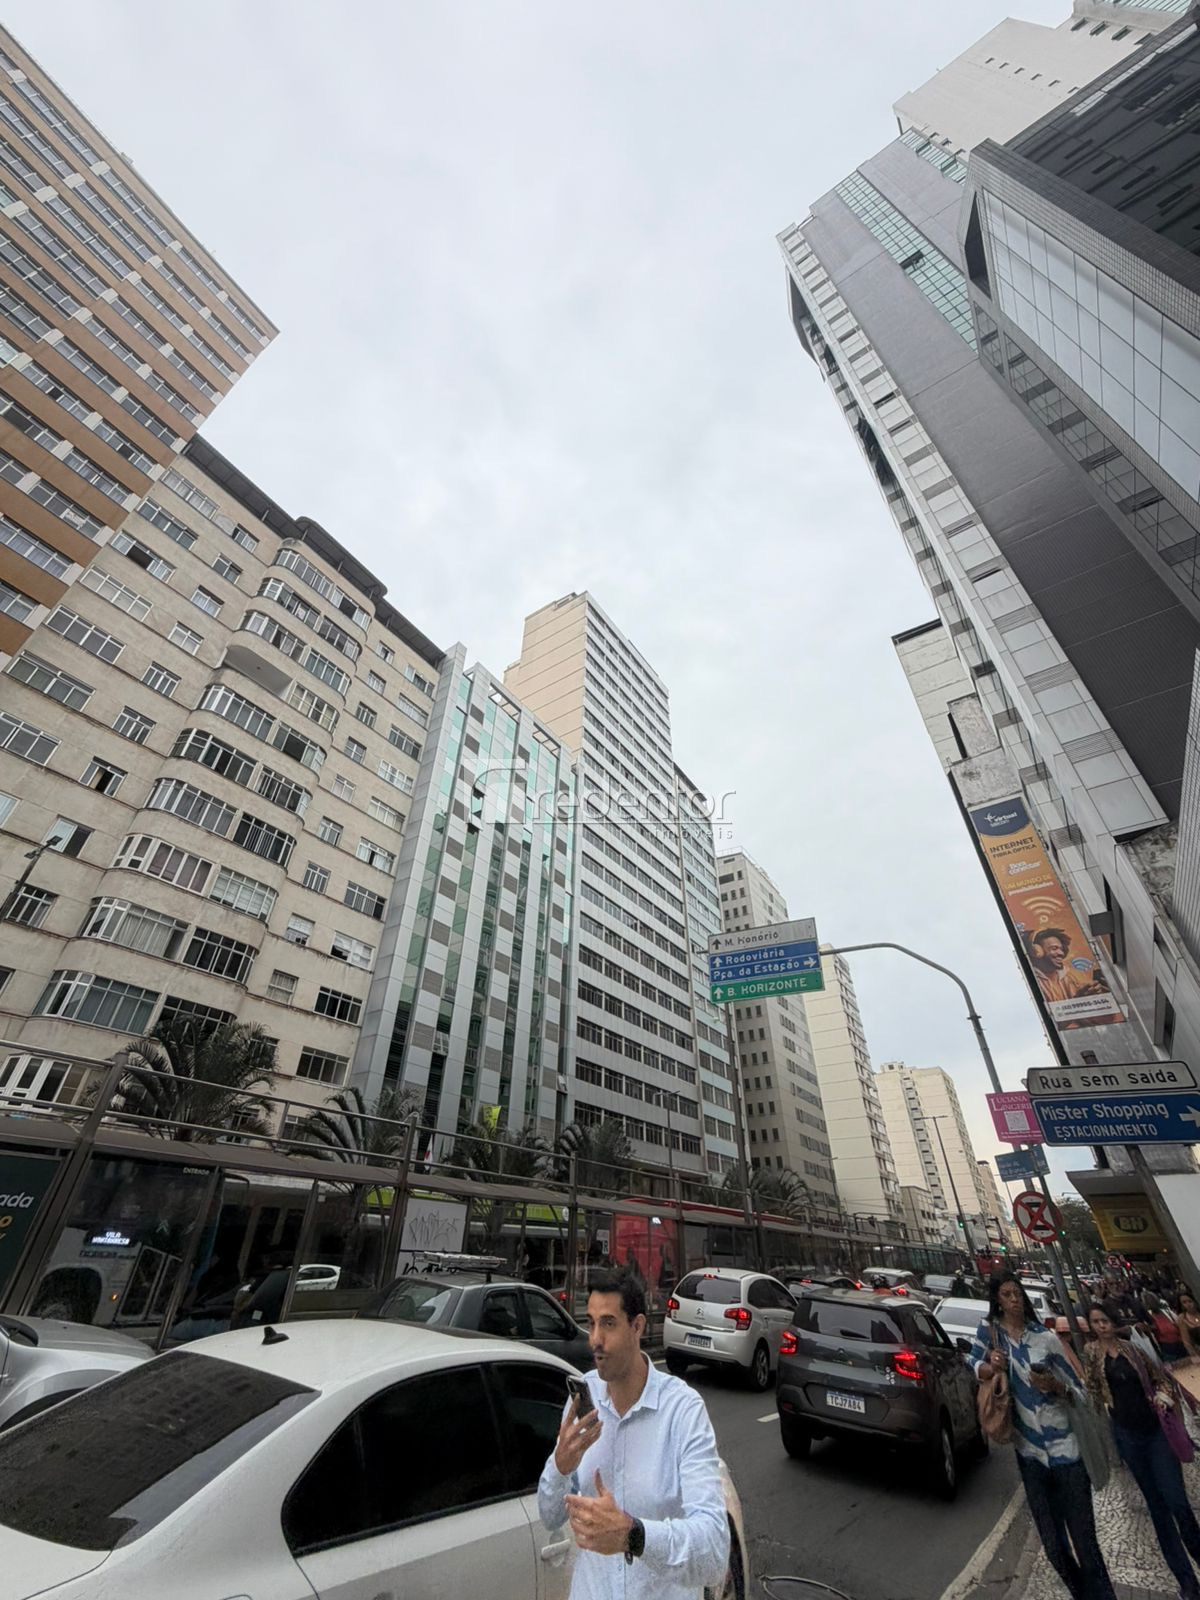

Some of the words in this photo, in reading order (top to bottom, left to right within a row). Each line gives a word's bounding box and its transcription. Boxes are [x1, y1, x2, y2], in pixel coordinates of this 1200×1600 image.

[990, 837, 1034, 853] INTERNET
[993, 850, 1013, 858] FIBRA
[725, 948, 785, 964] Rodoviária
[713, 970, 735, 980] Pça.
[739, 967, 751, 976] da
[754, 960, 800, 974] Estação
[727, 987, 737, 997] B.
[741, 978, 807, 995] HORIZONTE
[1039, 1075, 1072, 1090] Rua
[1080, 1074, 1120, 1088] sem
[1040, 1105, 1089, 1121] Mister
[1092, 1101, 1169, 1119] Shopping
[1054, 1124, 1158, 1138] ESTACIONAMENTO
